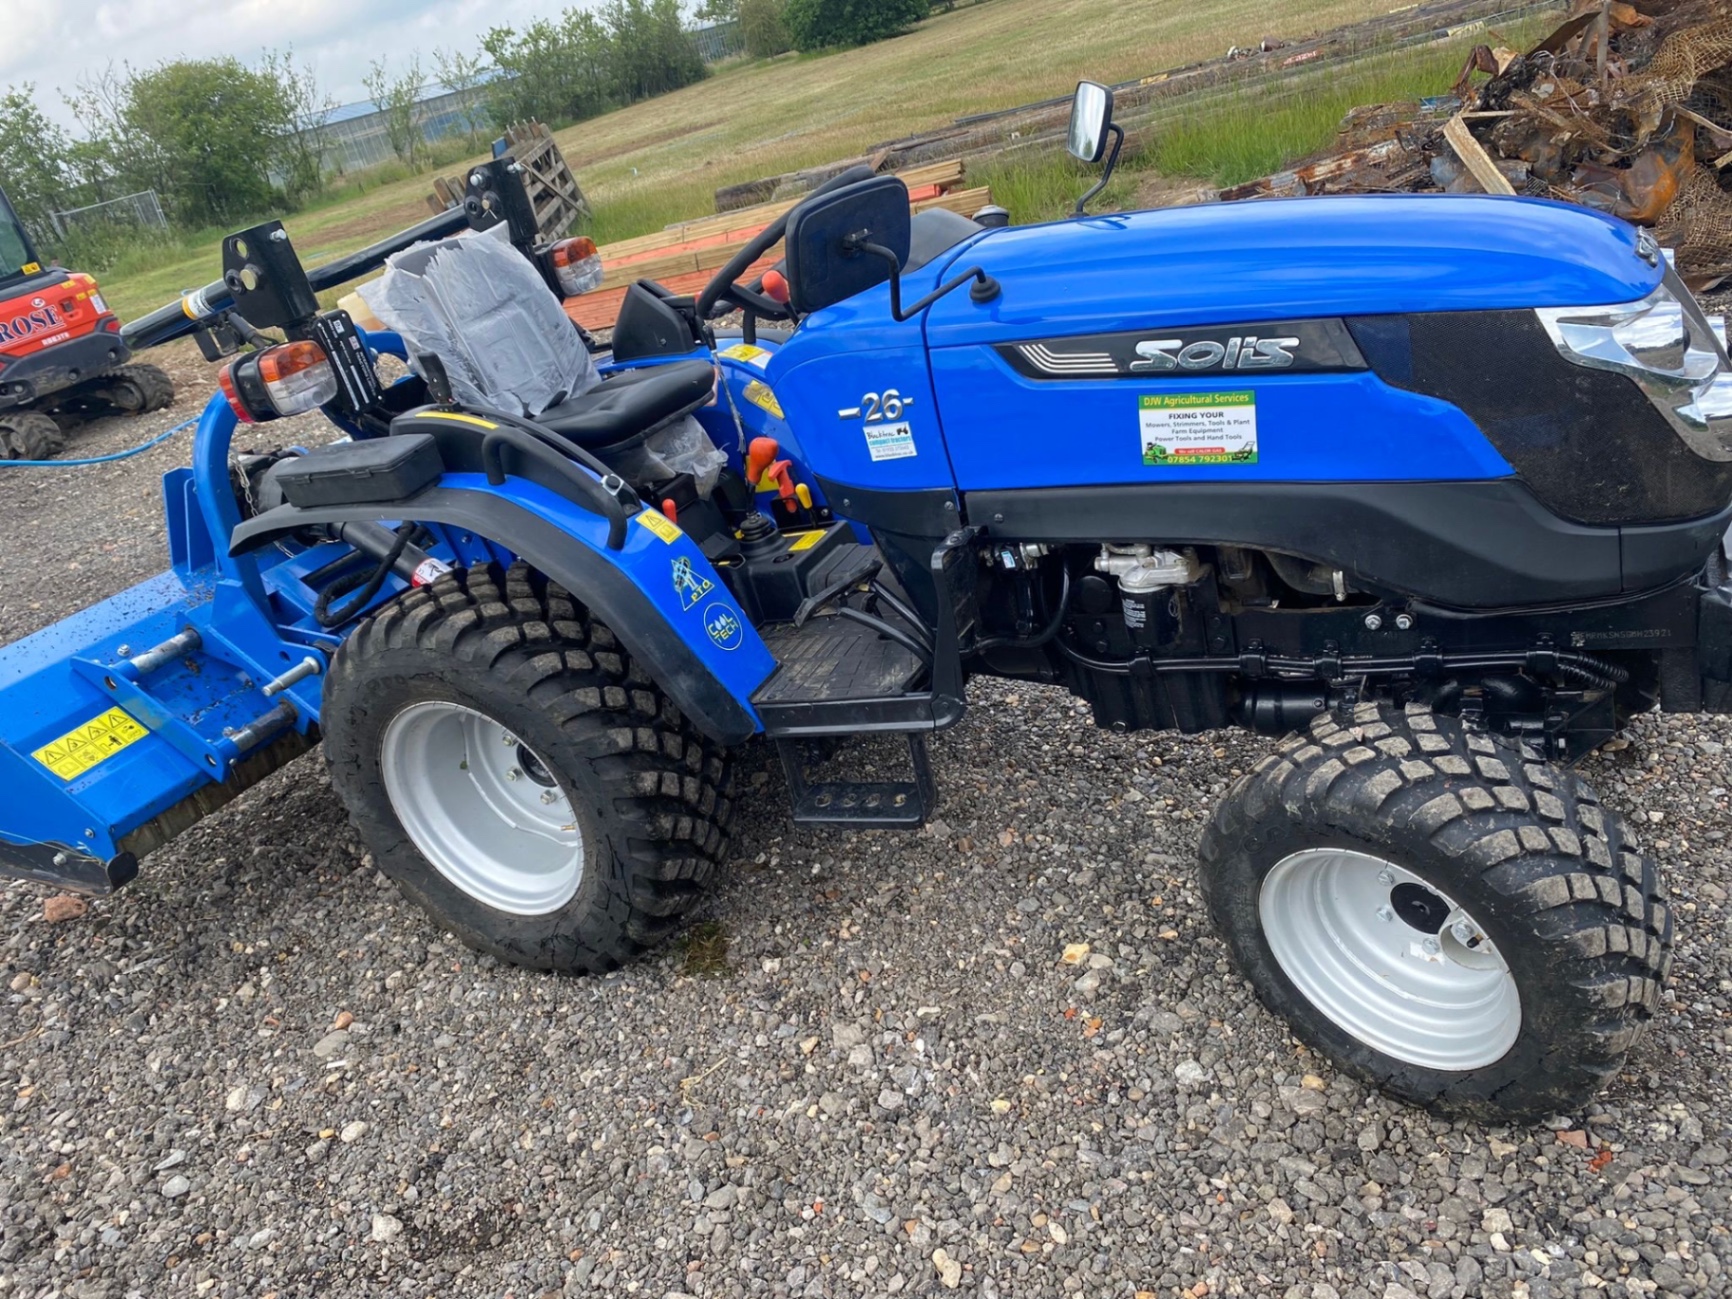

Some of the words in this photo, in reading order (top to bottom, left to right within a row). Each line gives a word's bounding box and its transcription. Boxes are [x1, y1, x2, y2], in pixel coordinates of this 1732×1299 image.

[1144, 396, 1161, 406] DJW
[1164, 394, 1213, 407] Agricultural
[1214, 393, 1249, 404] Services
[1168, 412, 1198, 420] FIXING
[1199, 411, 1224, 419] YOUR
[1145, 421, 1172, 429] Mowers,
[1173, 420, 1207, 428] Strimmers,
[1233, 418, 1250, 426] Plant
[1188, 427, 1223, 436] Equipment
[1167, 455, 1196, 463] 07854
[1199, 455, 1232, 463] 792301
[714, 620, 739, 643] TECH
